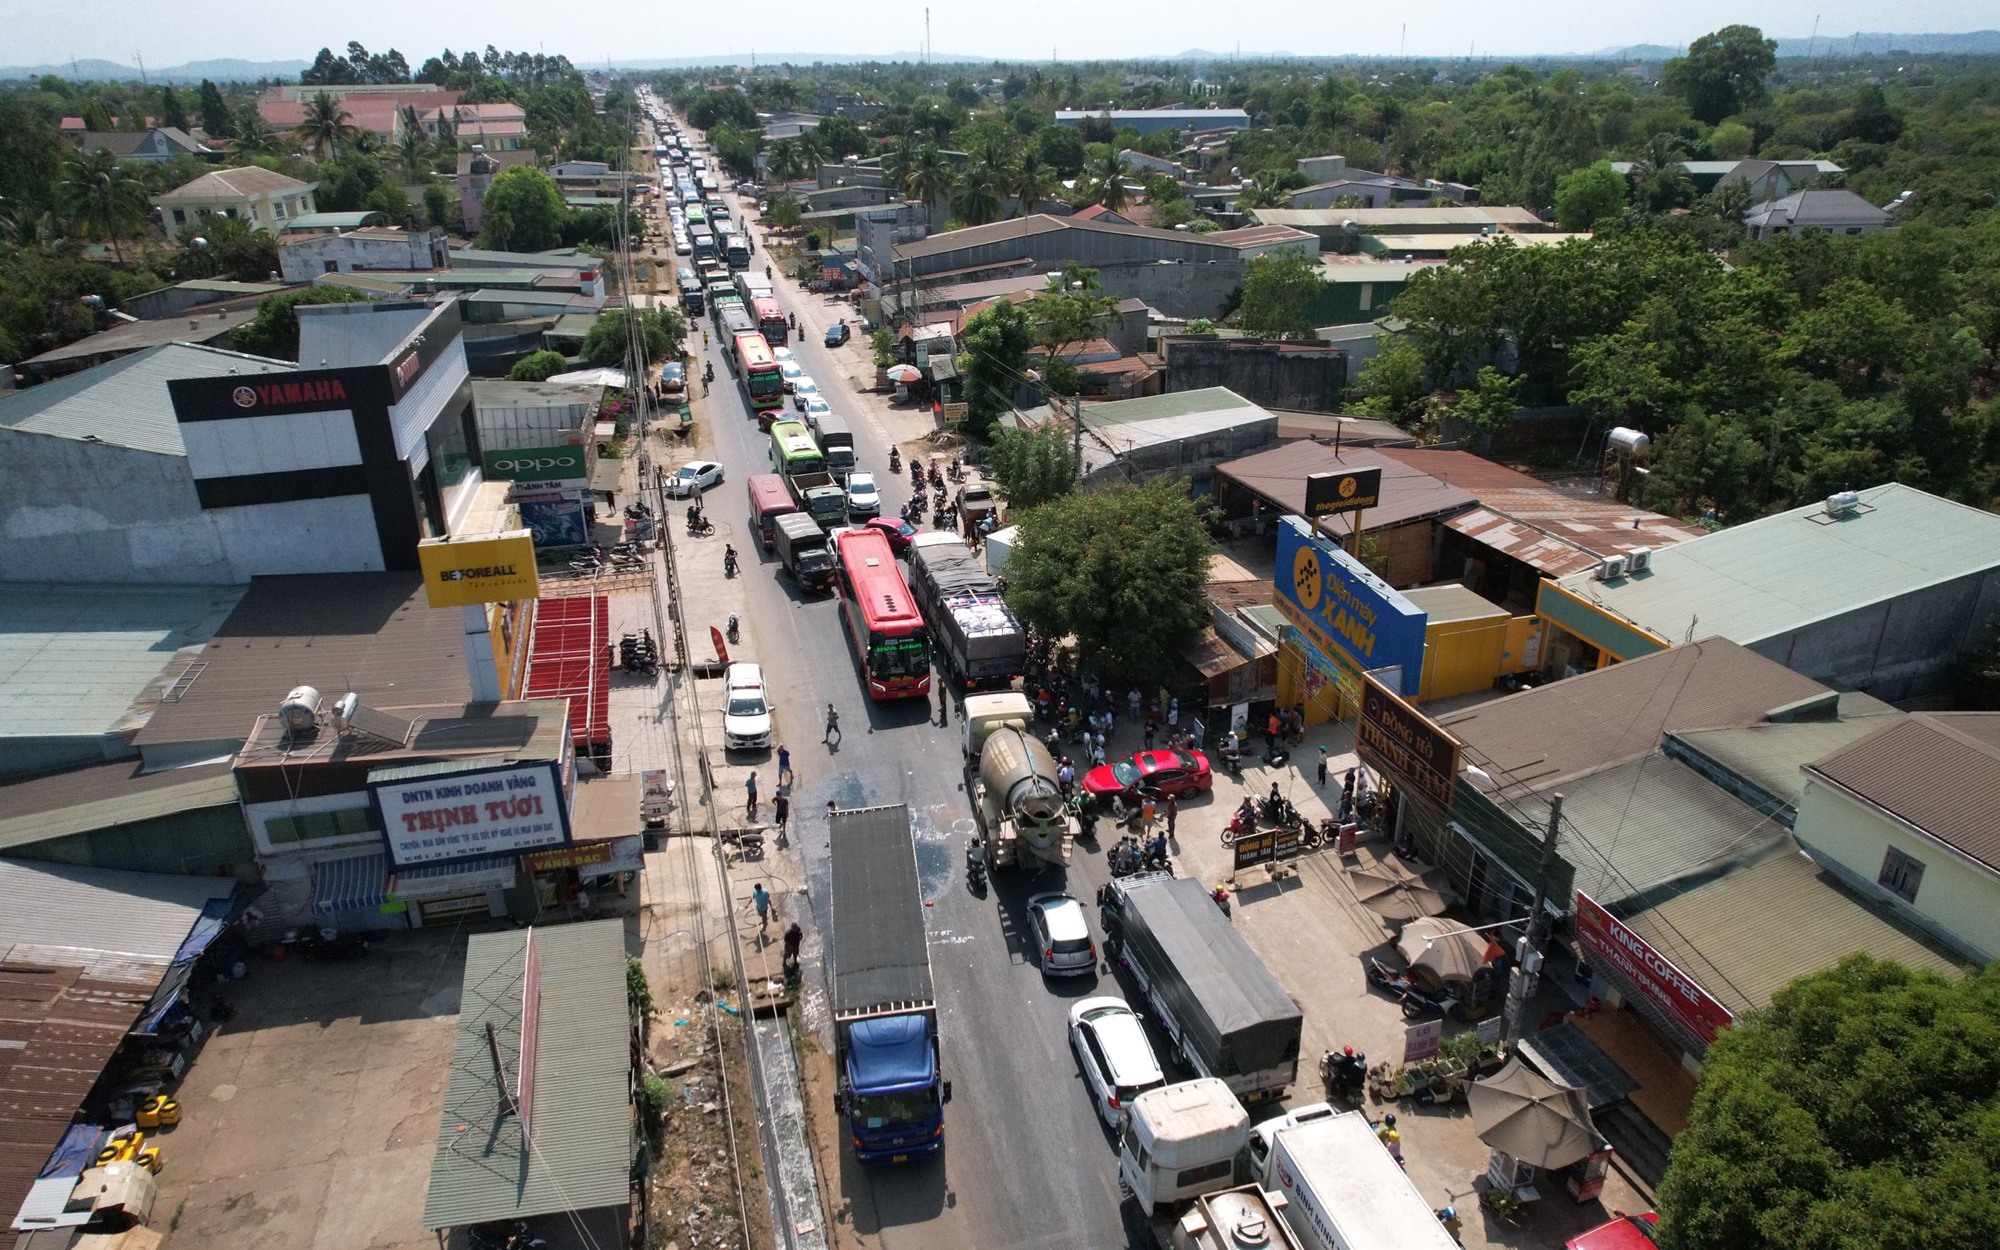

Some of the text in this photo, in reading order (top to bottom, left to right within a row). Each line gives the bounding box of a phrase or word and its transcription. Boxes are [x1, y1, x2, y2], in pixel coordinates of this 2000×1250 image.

[256, 378, 347, 406] YAMAHA
[1315, 495, 1376, 511] thegioididong
[440, 565, 517, 581] BEFOREALL
[1327, 572, 1378, 628] Điện máy
[1321, 594, 1377, 658] XANH
[1382, 710, 1434, 759] ĐỒNG HỒ
[402, 775, 536, 804] DNTN KINH DOANH VÀNG
[402, 804, 479, 833] THỊNH
[1609, 921, 1700, 1007] KING COFFEE
[1314, 1213, 1336, 1249] MINH
